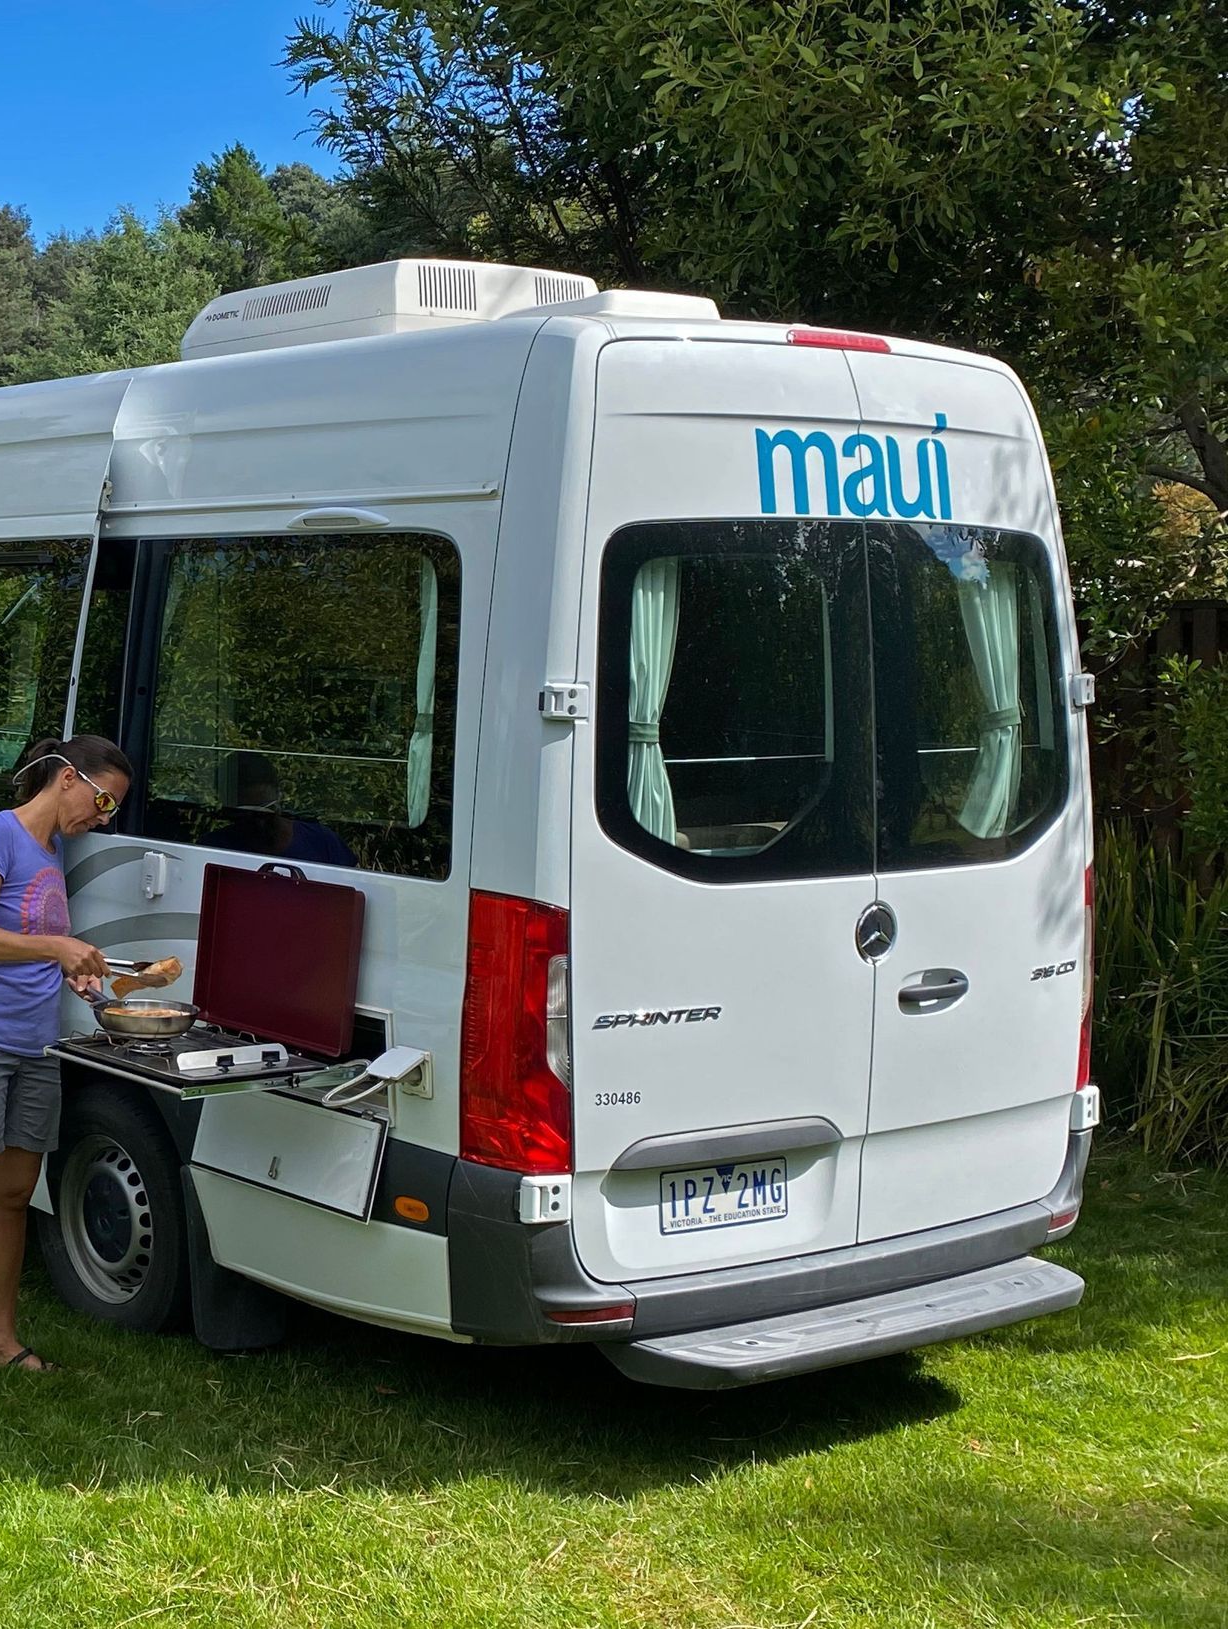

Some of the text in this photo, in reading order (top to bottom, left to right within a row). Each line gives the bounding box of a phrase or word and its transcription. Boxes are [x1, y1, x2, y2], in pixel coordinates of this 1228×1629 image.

[212, 310, 240, 321] DOMETIC
[755, 412, 952, 521] maui
[591, 1005, 722, 1031] SPRINTER
[594, 1091, 641, 1106] 330486
[669, 1167, 782, 1218] 1PZ 2MG
[670, 1216, 703, 1228] VICTORIA
[708, 1213, 723, 1222] THE
[723, 1207, 761, 1221] EDUCATION
[762, 1205, 782, 1216] STATE
